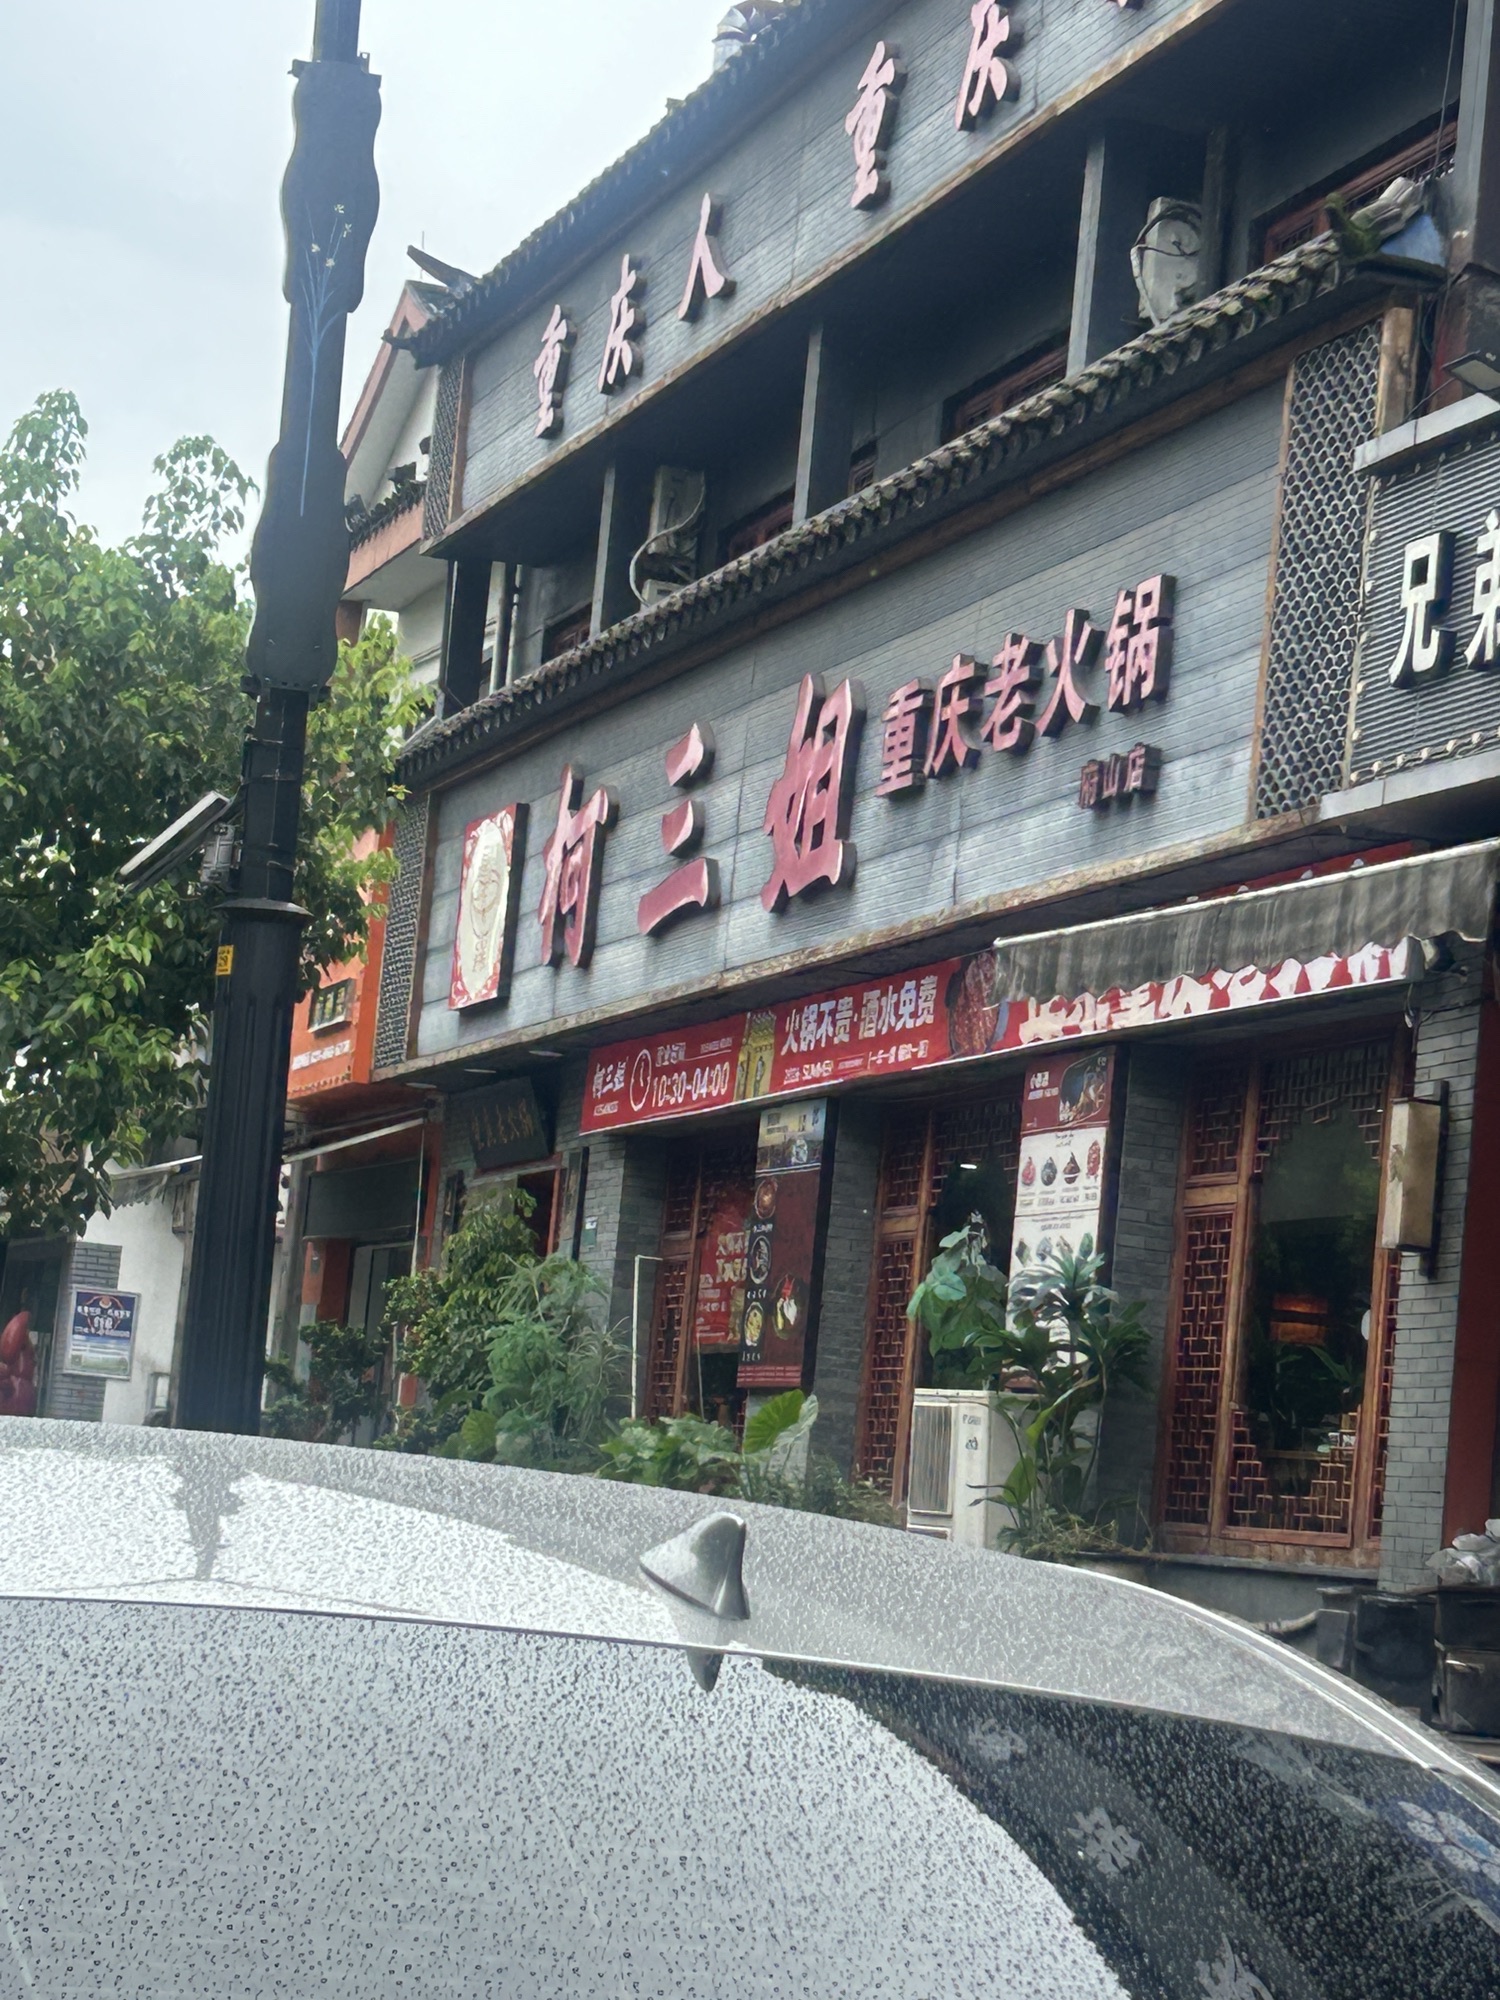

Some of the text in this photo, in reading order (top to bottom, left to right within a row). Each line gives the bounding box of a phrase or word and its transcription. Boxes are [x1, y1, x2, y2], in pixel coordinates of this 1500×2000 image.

[875, 574, 1166, 797] 重庆老火锅
